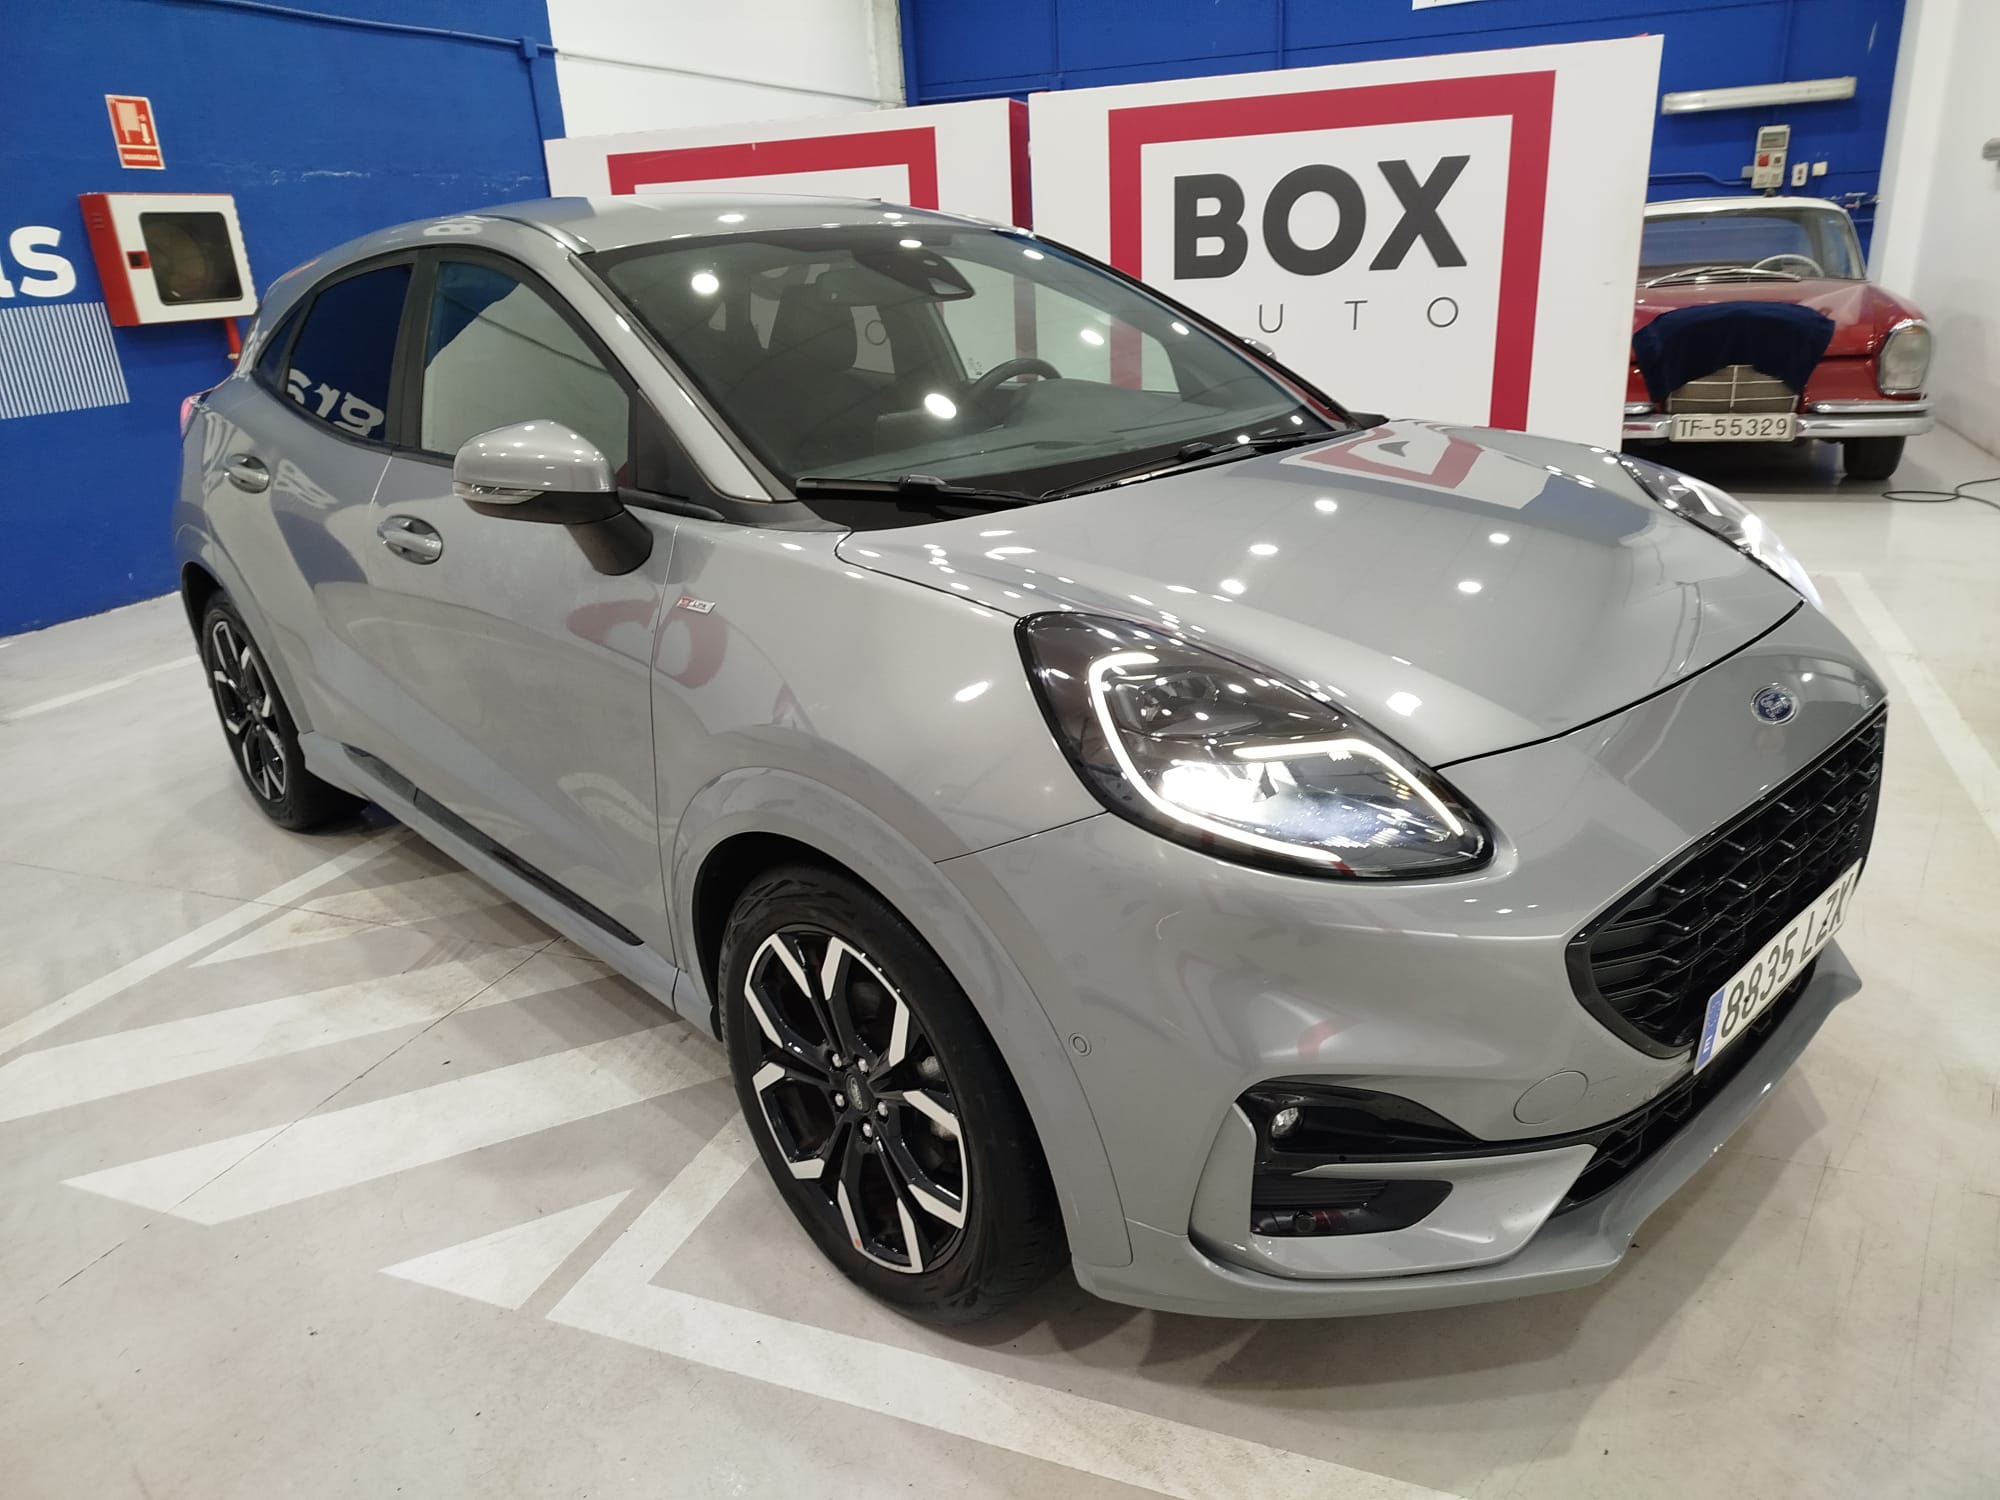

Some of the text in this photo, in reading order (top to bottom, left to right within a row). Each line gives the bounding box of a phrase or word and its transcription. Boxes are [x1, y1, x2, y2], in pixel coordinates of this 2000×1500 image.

[1174, 155, 1471, 280] BOX
[0, 226, 77, 298] s
[1258, 297, 1459, 333] UTO
[1678, 417, 1788, 437] TF-55329
[1721, 872, 1855, 1038] 8835 LZK
